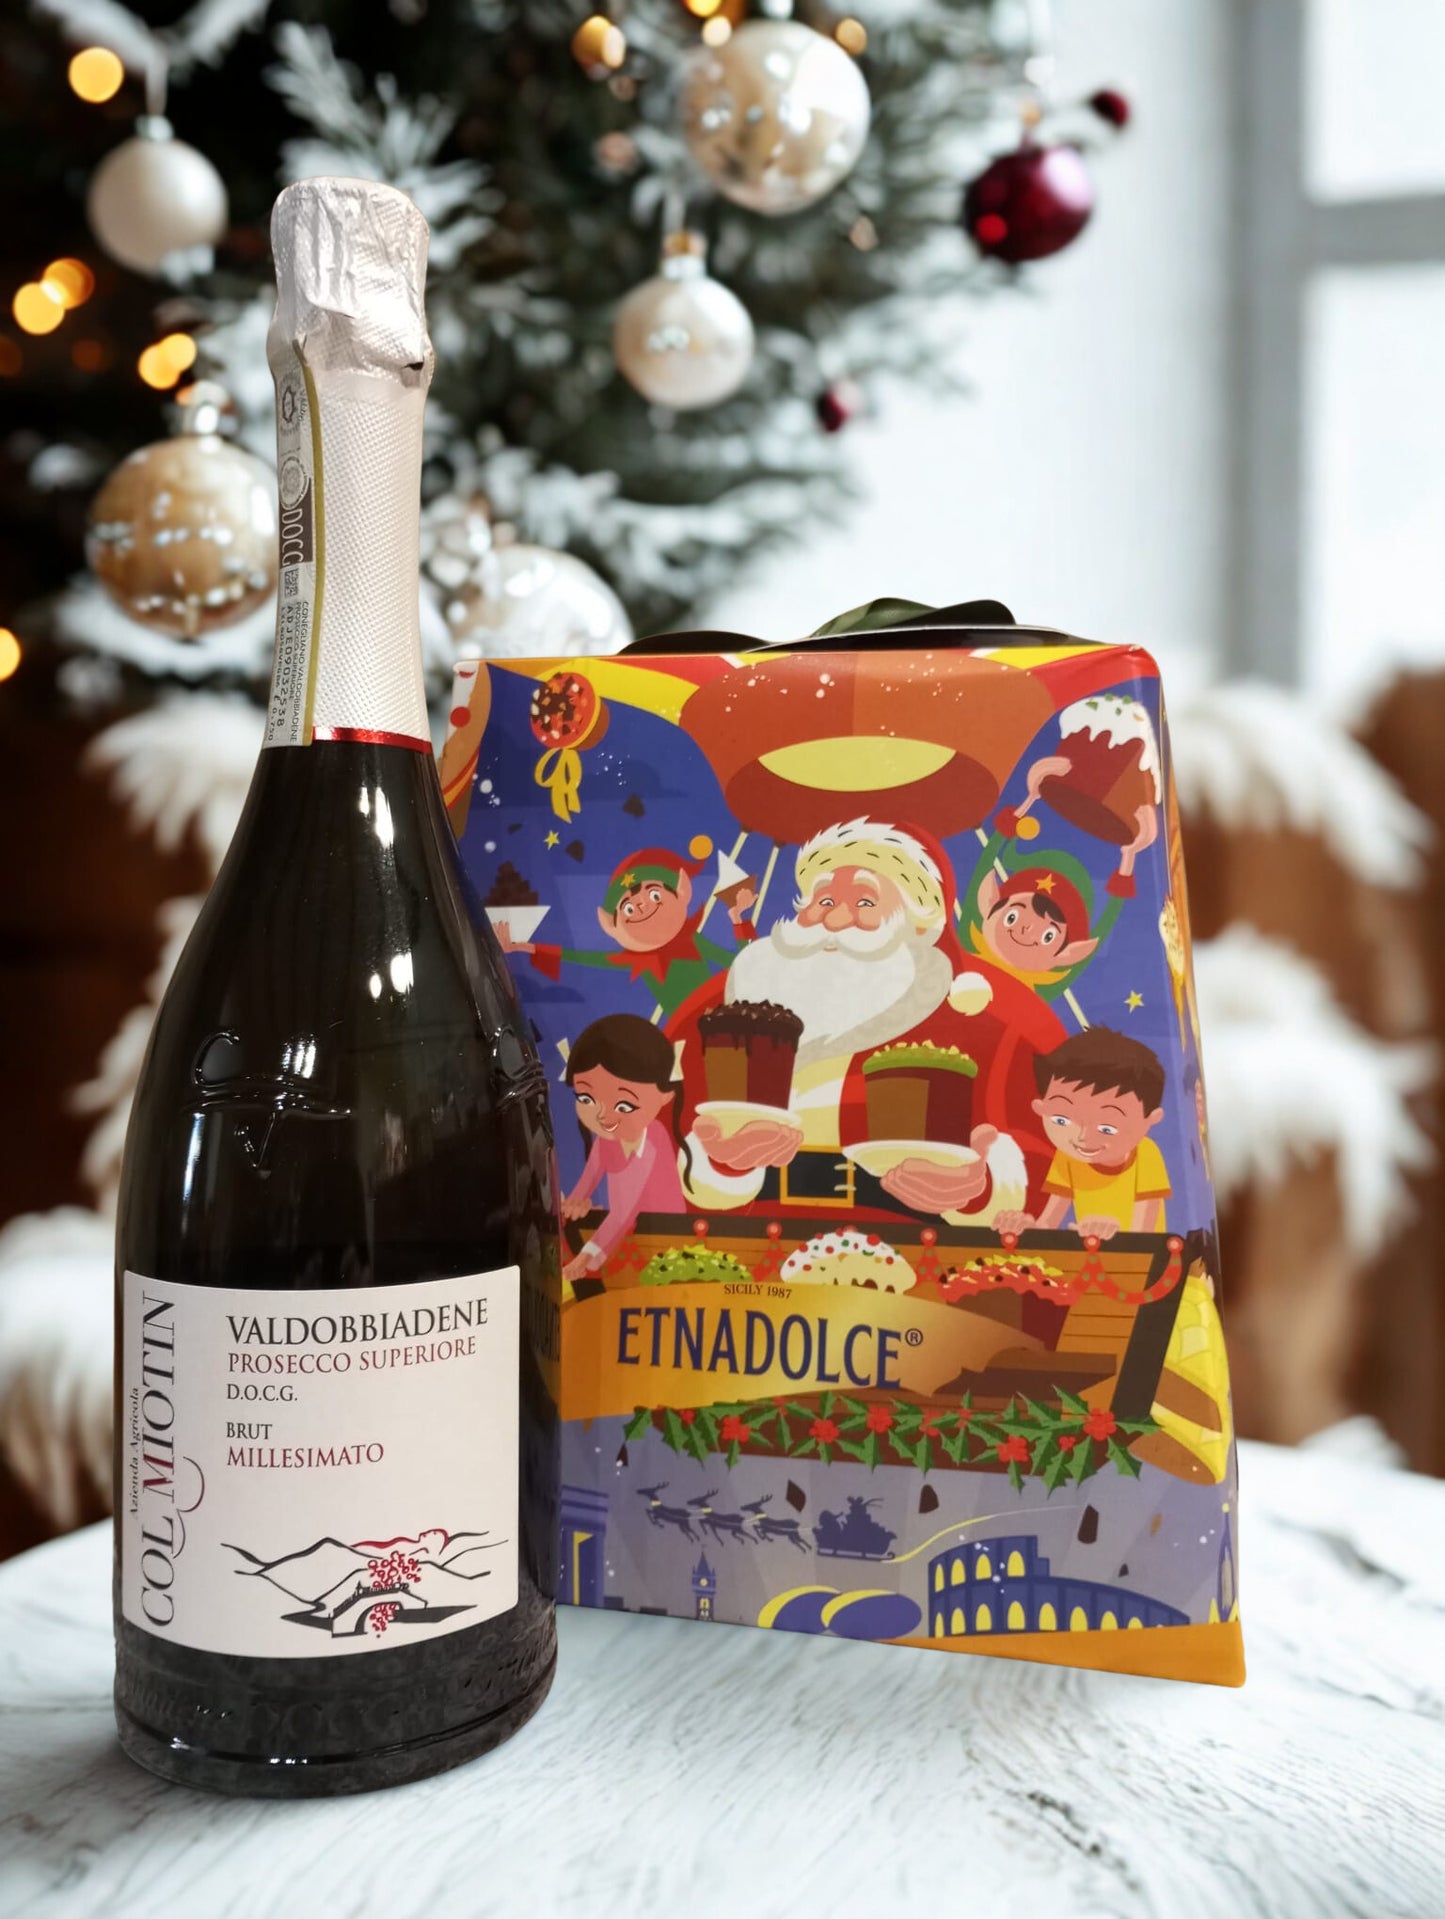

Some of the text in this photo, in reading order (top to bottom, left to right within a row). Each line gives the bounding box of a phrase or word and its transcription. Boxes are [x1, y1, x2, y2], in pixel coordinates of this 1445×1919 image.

[281, 508, 304, 567] DOCG
[724, 1283, 793, 1300] SICILY 1987
[225, 1297, 489, 1345] VALDOBBIADENE
[228, 1335, 477, 1375] PROSECCO SUPERIORE
[226, 1383, 299, 1402] D.O.C.G.
[225, 1422, 273, 1441] BRUT
[129, 1387, 141, 1520] Azienda Agricola
[140, 1289, 176, 1627] COL MIOTIN
[226, 1442, 386, 1469] MILLESIMATO
